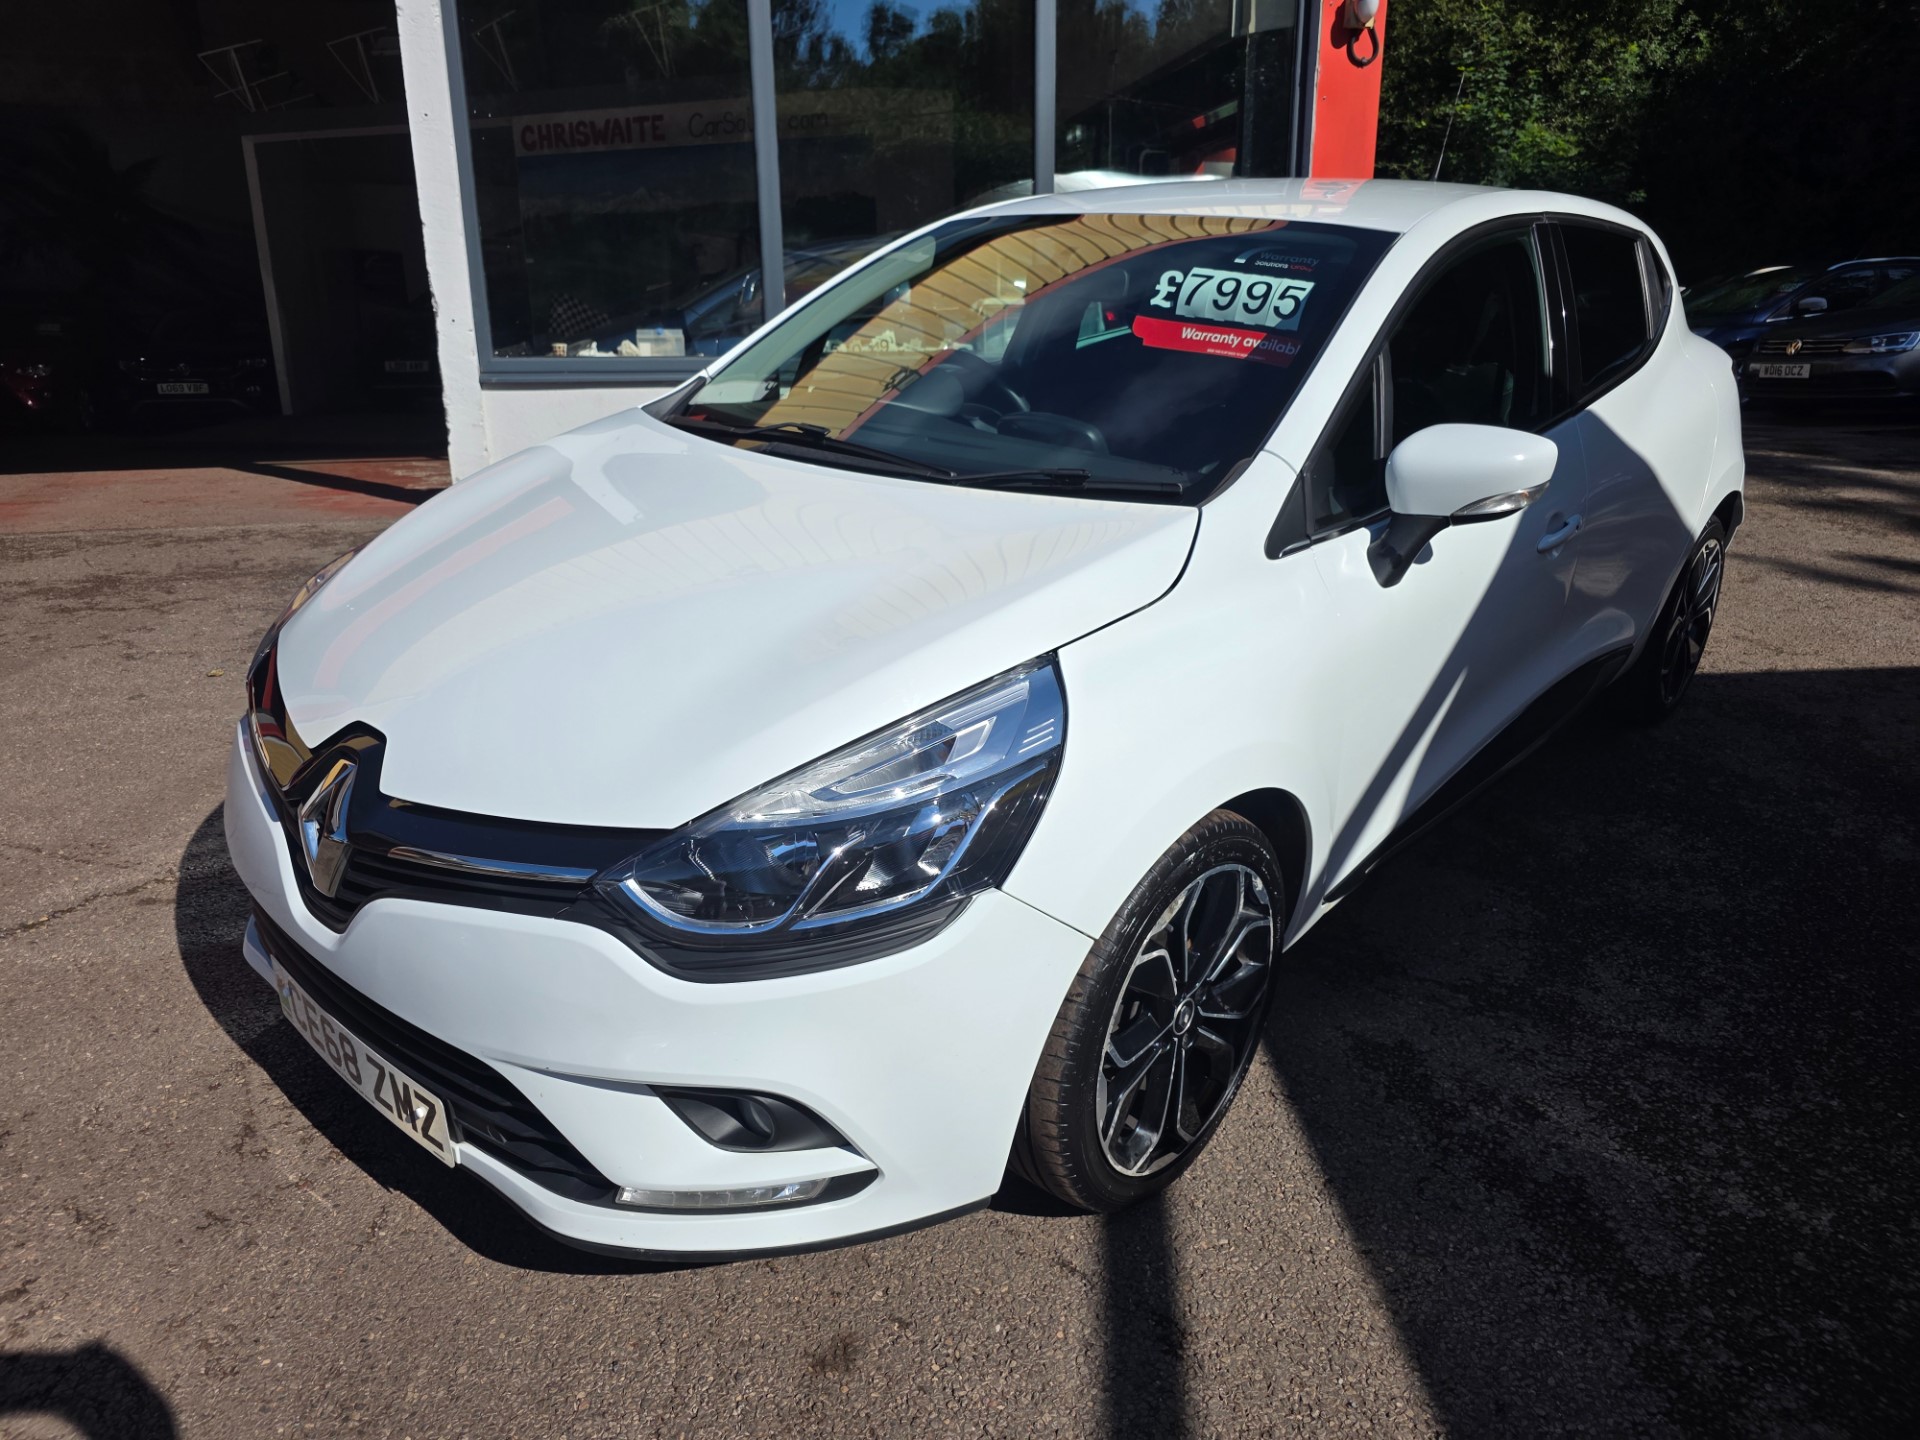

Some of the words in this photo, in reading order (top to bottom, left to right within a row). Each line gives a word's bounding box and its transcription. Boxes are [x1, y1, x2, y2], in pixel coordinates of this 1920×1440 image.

[521, 115, 666, 151] CHRISWAITE
[1259, 252, 1320, 265] Warranty
[1150, 269, 1308, 320] £7995
[1181, 327, 1241, 348] Warranty
[287, 980, 363, 1086] CE68
[366, 1054, 445, 1152] ZMZ
